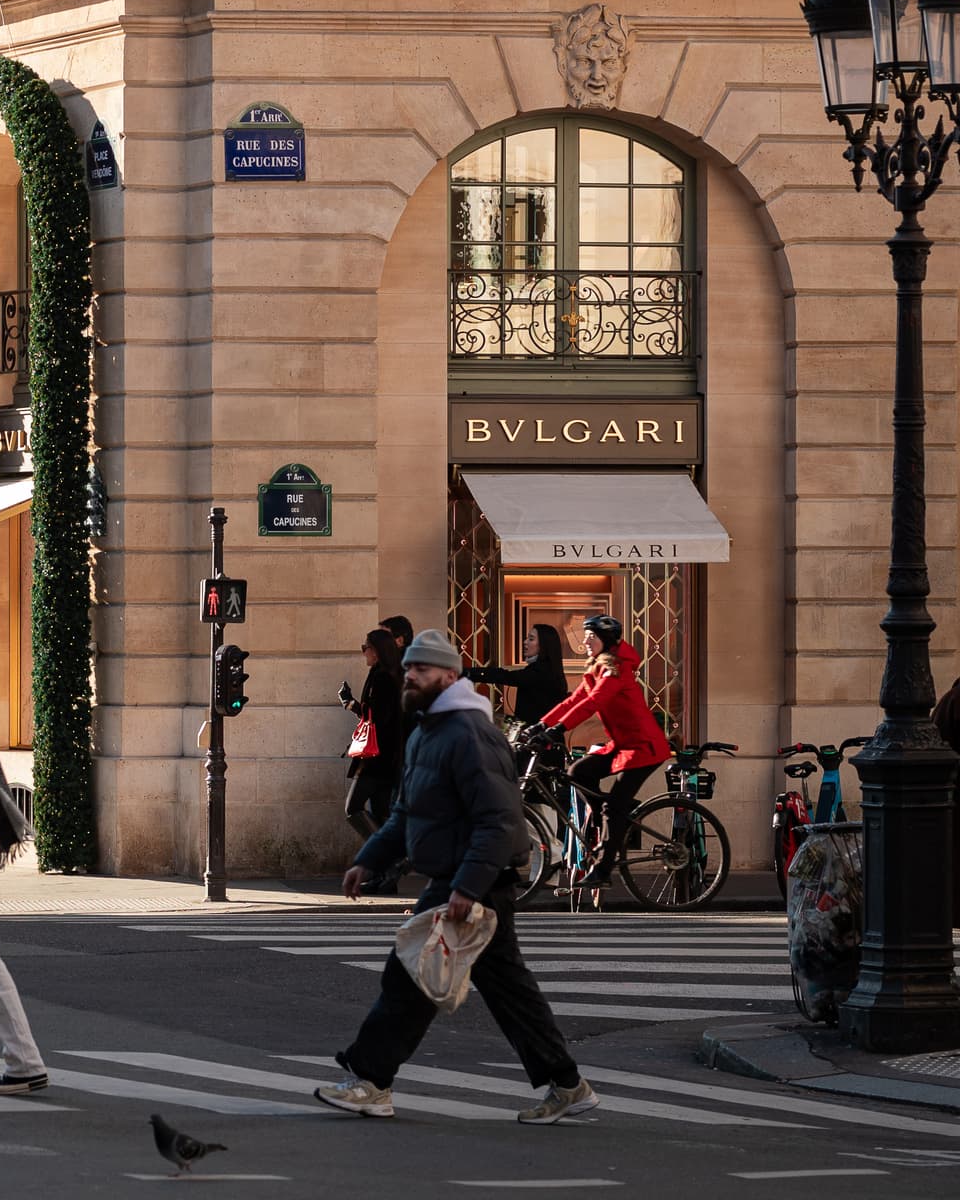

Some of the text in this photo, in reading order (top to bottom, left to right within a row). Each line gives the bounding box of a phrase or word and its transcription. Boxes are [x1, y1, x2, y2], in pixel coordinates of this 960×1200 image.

[236, 140, 295, 151] RUE DES
[95, 150, 109, 161] PLACE
[232, 156, 299, 168] CAPUCINES
[465, 419, 685, 444] BVLGARI
[286, 494, 304, 504] RUE
[273, 517, 318, 527] CAPUCINES
[552, 544, 678, 559] BVLGARI
